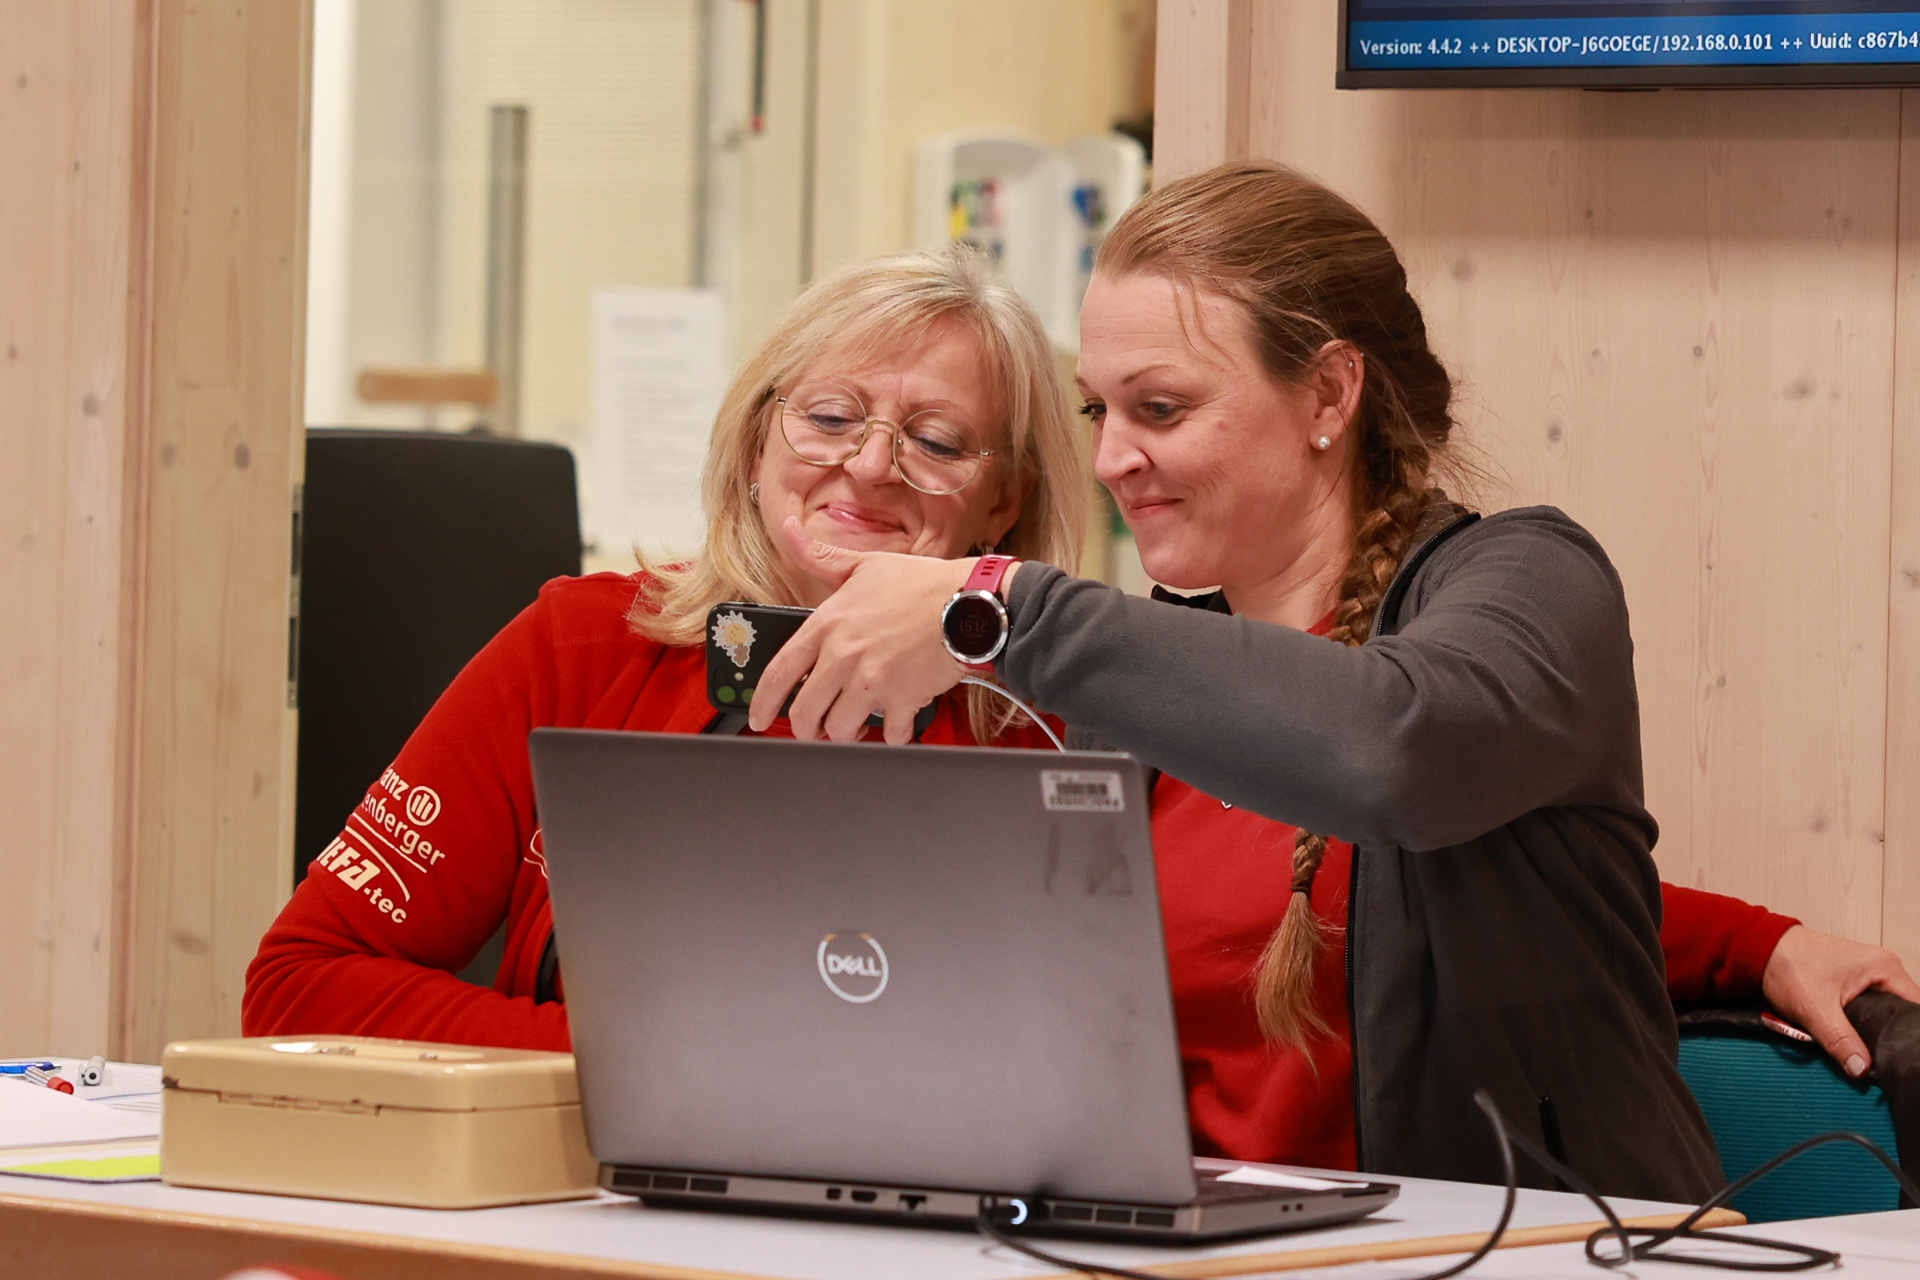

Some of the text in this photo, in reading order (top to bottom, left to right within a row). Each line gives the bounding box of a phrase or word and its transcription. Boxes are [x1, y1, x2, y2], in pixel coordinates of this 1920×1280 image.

[1360, 39, 1422, 55] Version:
[1427, 38, 1462, 54] 4.4.2
[1469, 41, 1491, 53] ++
[1780, 37, 1803, 49] ++
[1810, 32, 1852, 49] Uuid:
[1858, 30, 1920, 49] c867b4
[380, 763, 409, 801] anz
[826, 953, 882, 977] DELL
